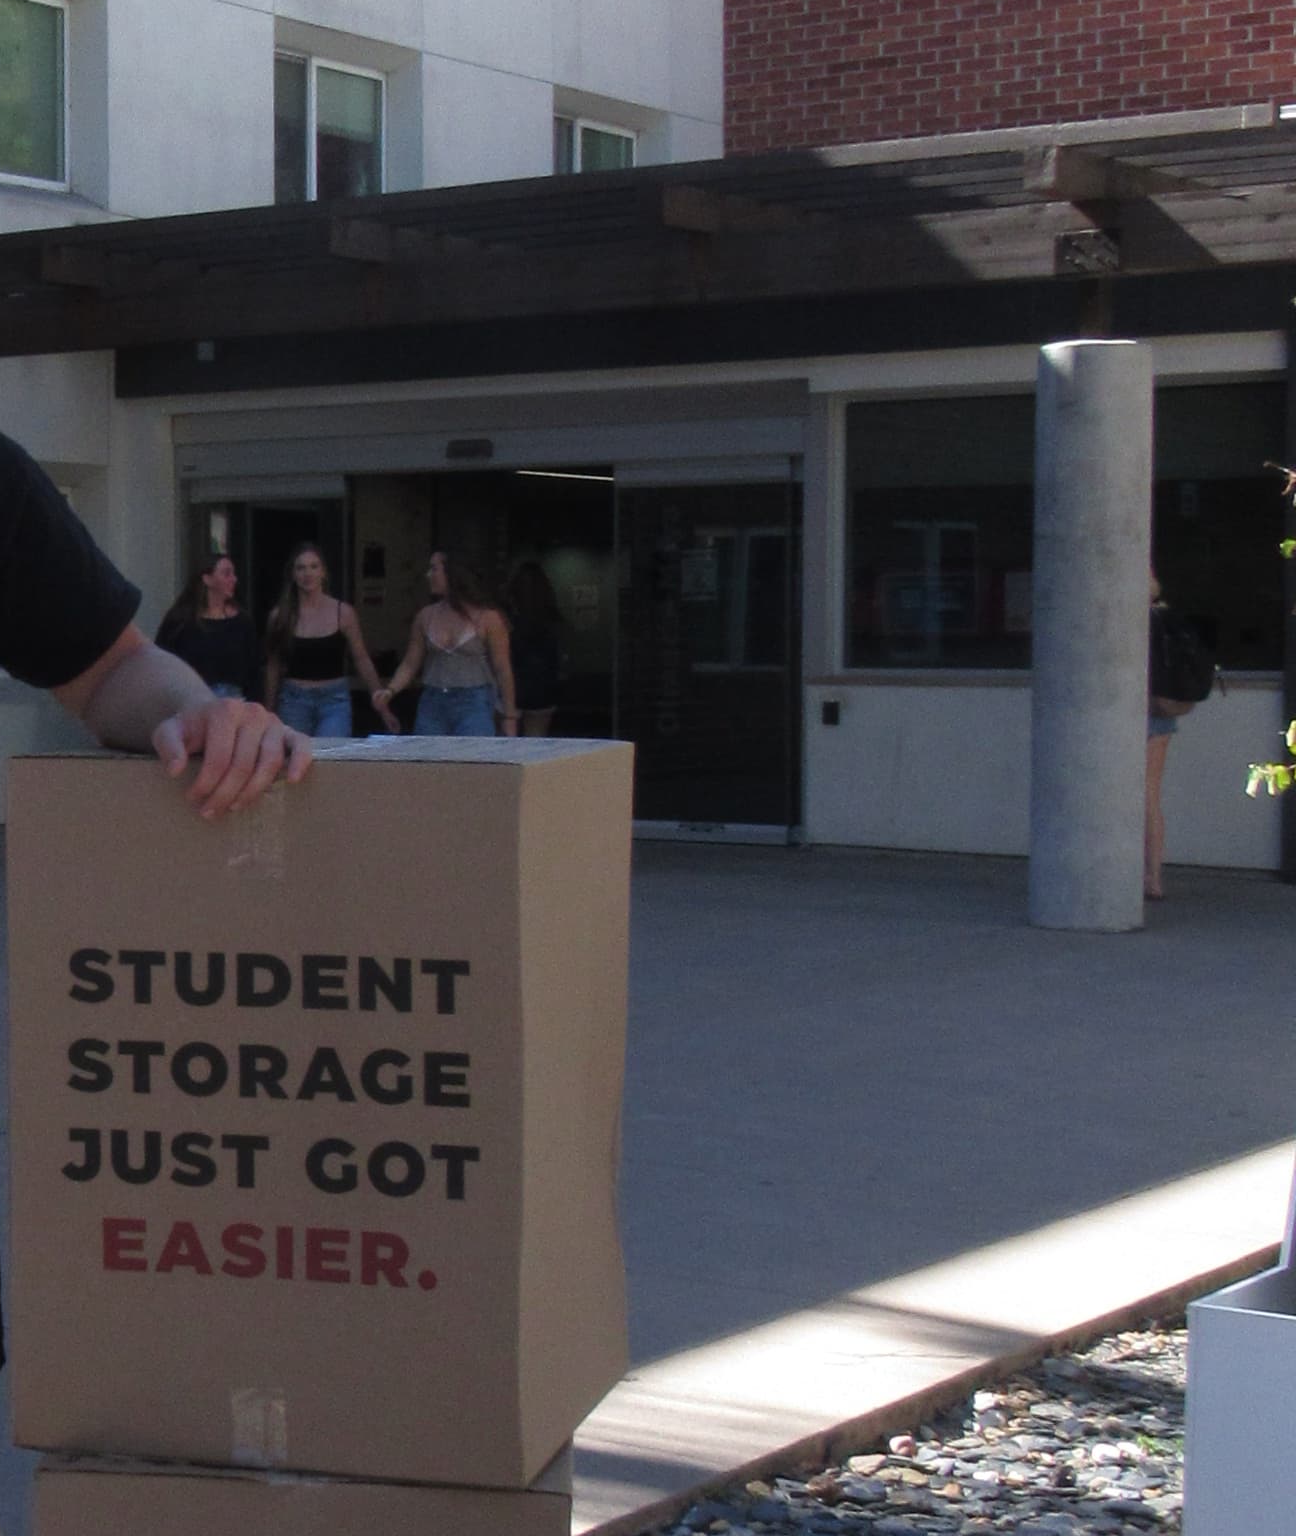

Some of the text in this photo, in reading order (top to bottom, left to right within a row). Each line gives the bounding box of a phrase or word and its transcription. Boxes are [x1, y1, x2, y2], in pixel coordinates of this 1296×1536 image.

[68, 948, 470, 1015] STUDENT
[66, 1038, 471, 1107] STORAGE
[61, 1127, 480, 1201] JUST GOT
[103, 1217, 438, 1291] EASIER.
